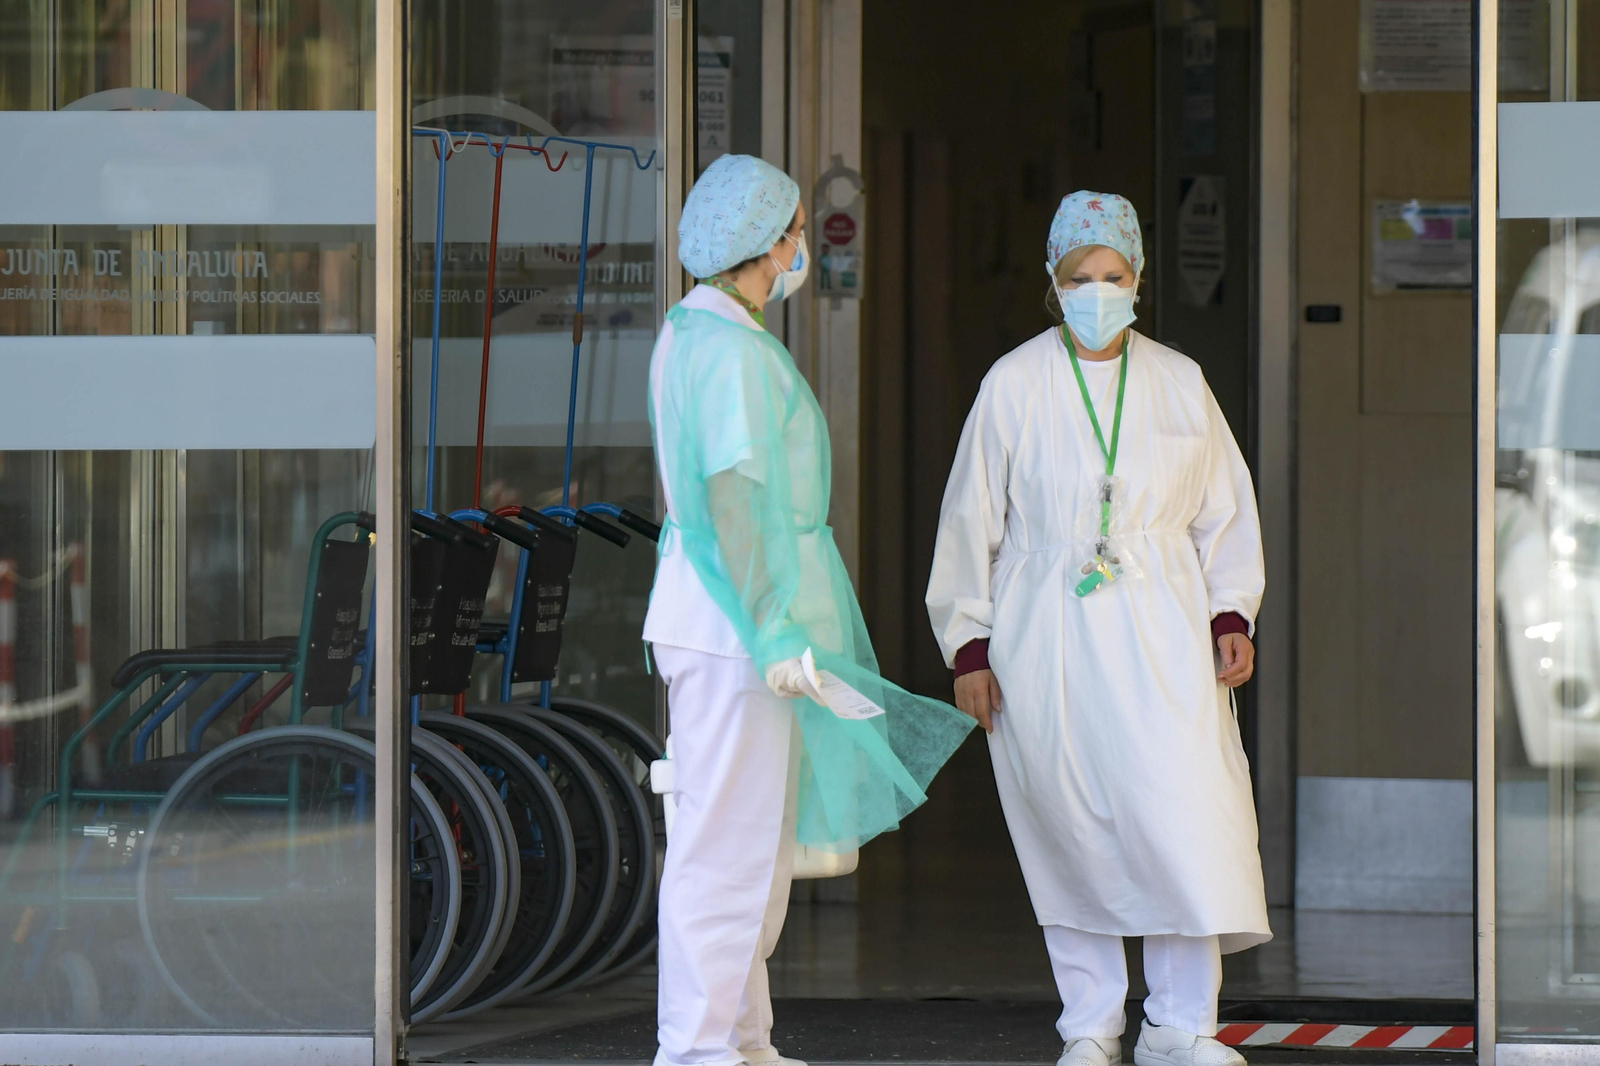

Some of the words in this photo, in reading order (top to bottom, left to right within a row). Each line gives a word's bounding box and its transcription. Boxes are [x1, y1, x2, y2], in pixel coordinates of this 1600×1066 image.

[1, 249, 79, 276] JUNTA
[93, 250, 122, 276] DE
[136, 250, 268, 278] ANDALUCIA
[40, 288, 57, 300] DE
[192, 287, 257, 303] POLÍTICAS
[260, 291, 320, 304] SOCIALES
